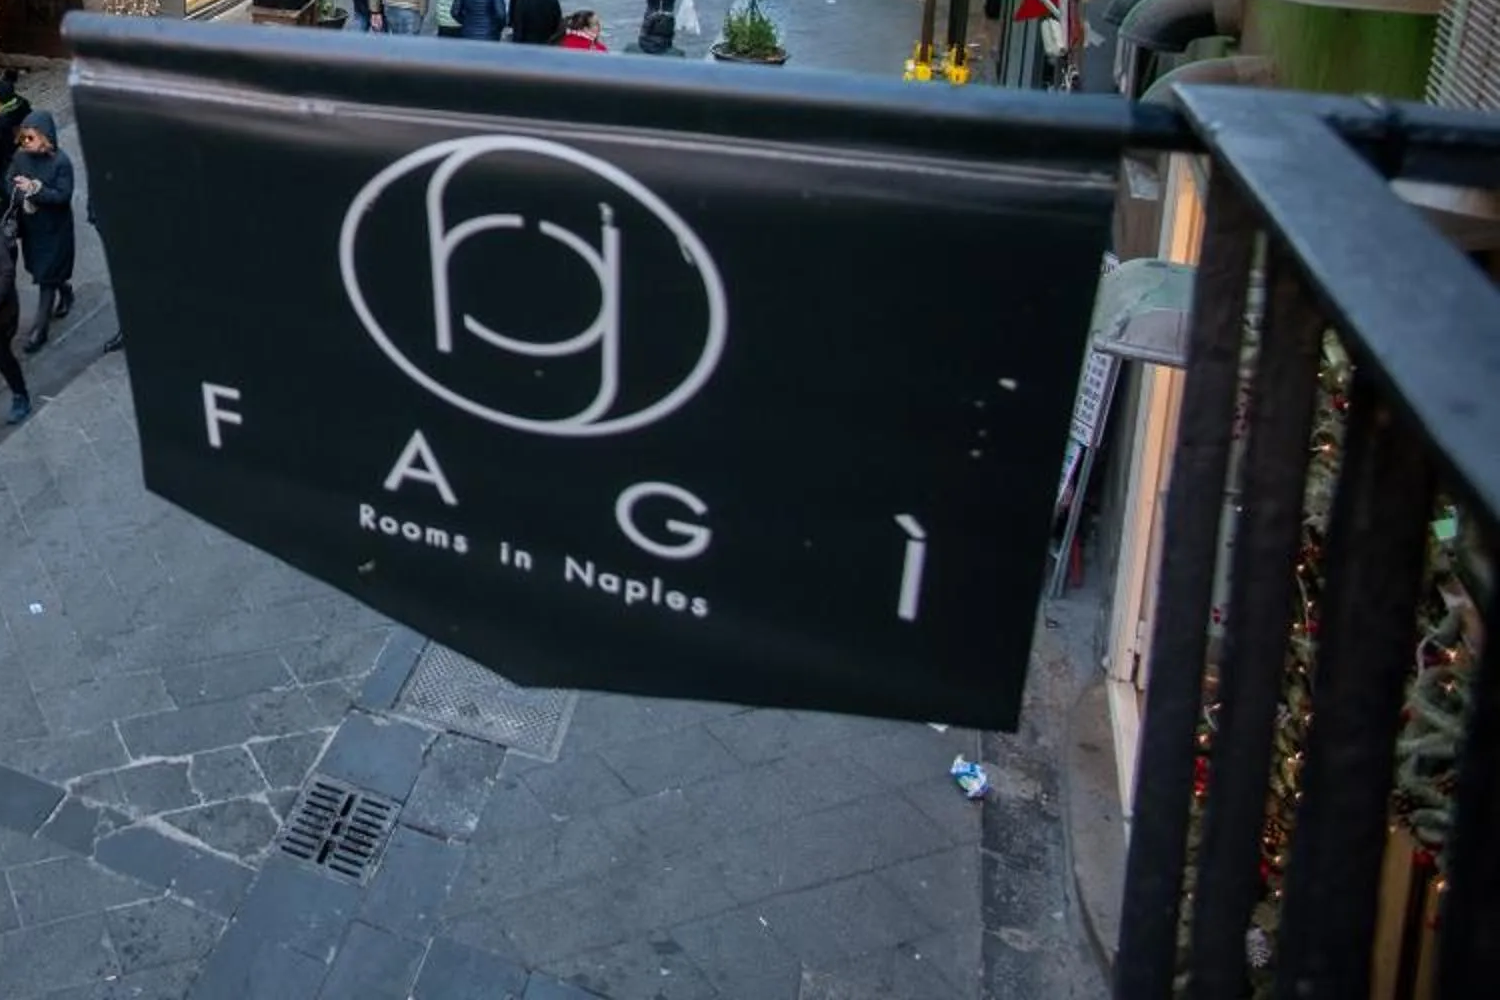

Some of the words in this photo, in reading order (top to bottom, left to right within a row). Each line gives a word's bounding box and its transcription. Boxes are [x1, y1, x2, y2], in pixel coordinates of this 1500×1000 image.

[359, 503, 469, 554] Rooms
[500, 541, 532, 571] in
[565, 555, 709, 618] Naples
